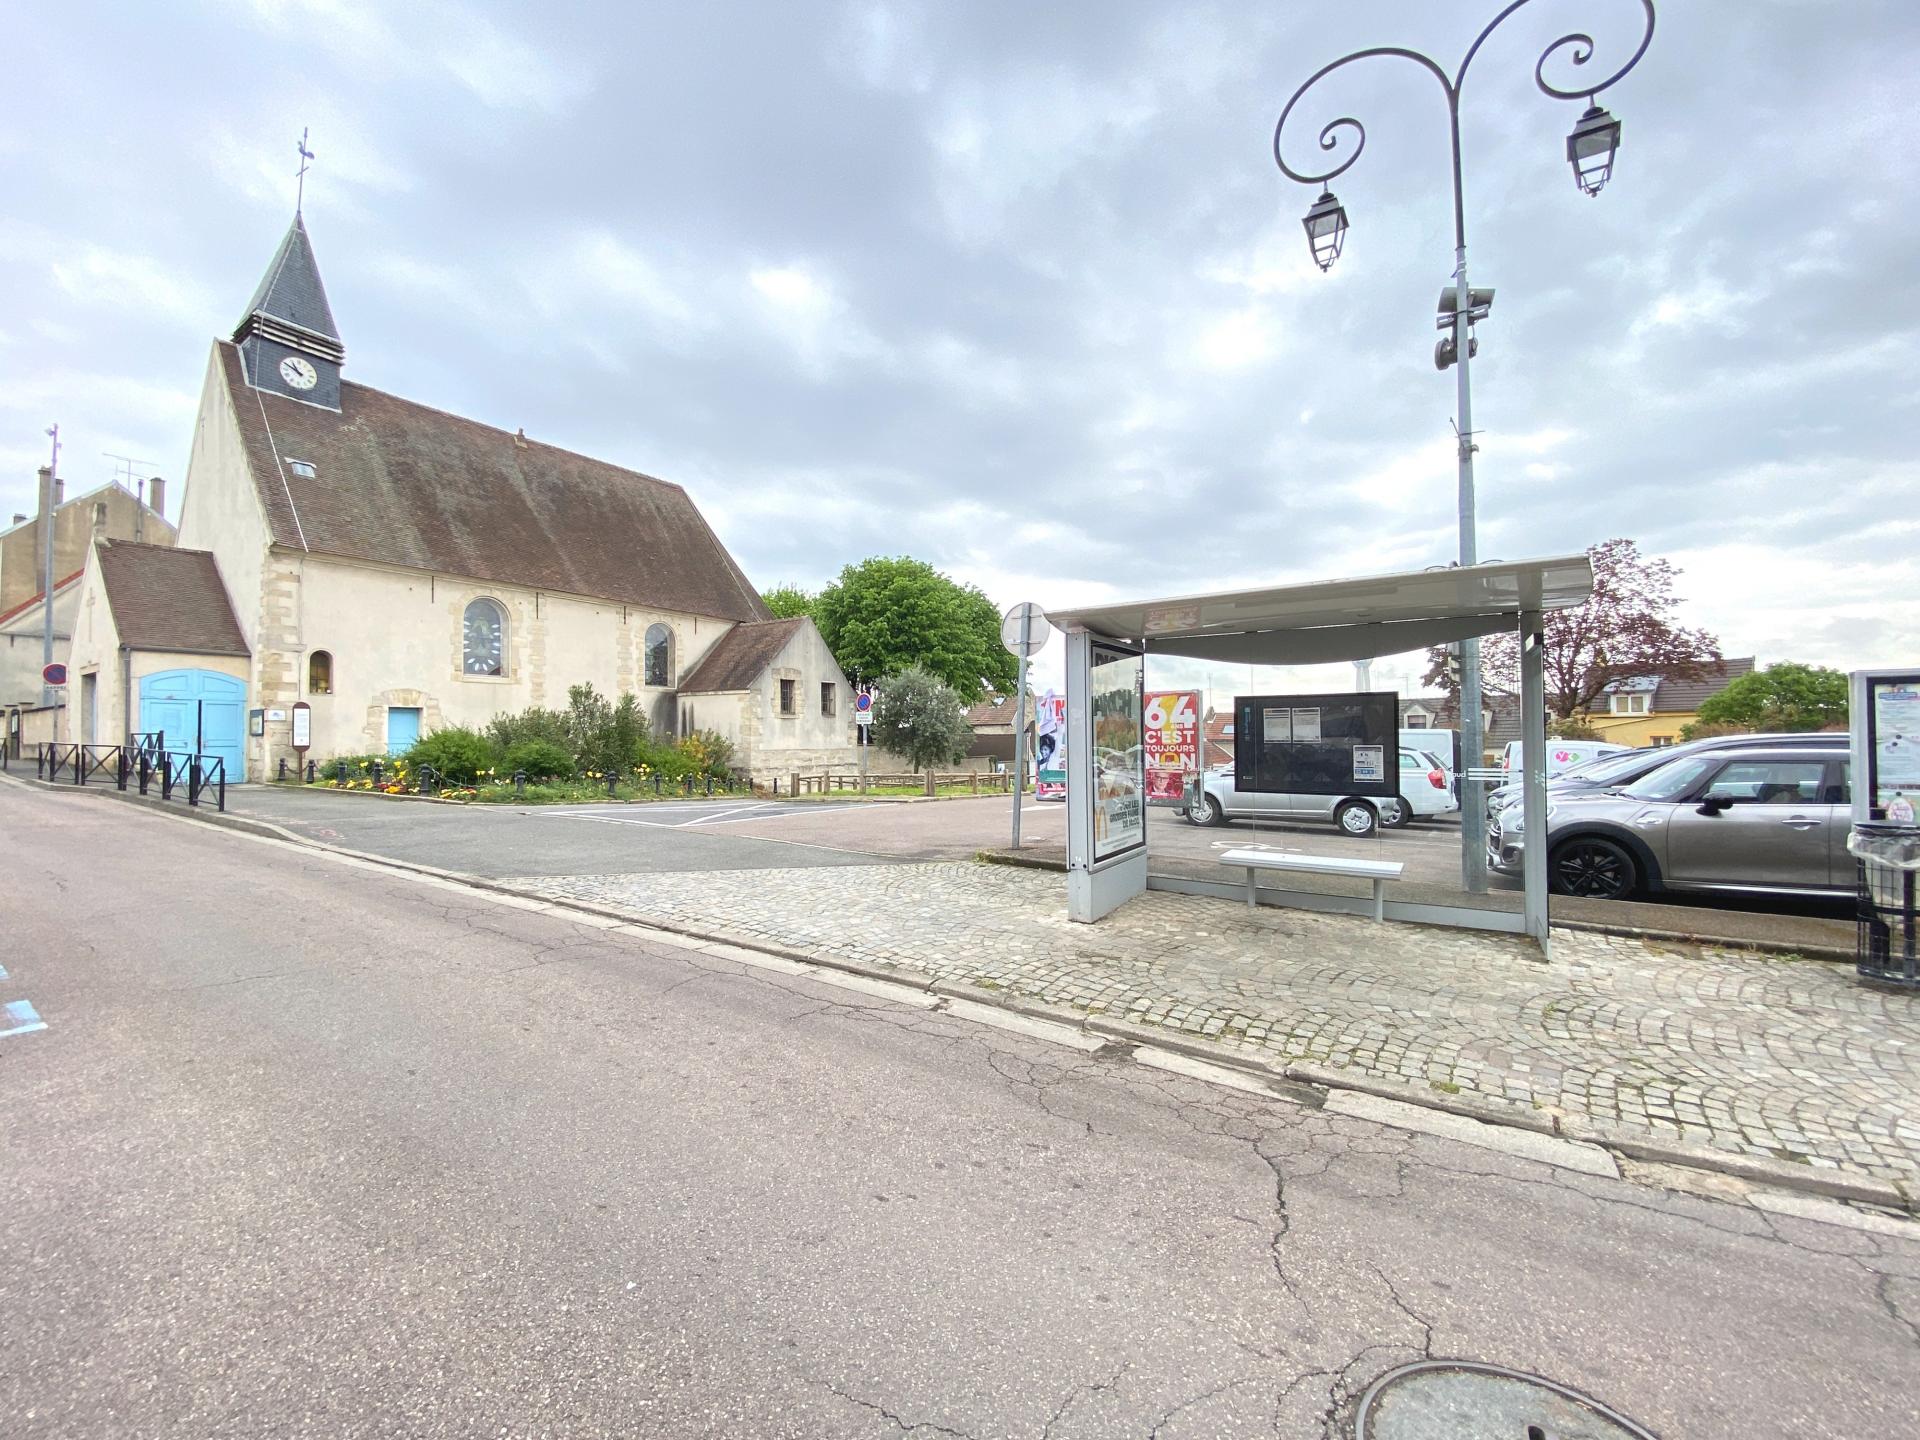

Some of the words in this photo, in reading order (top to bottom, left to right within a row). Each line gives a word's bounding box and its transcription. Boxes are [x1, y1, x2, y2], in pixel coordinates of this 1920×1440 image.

[1145, 696, 1196, 729] 64
[1145, 730, 1195, 744] C'EST
[1145, 744, 1196, 753] TOUJOURS
[1145, 752, 1196, 771] NON
